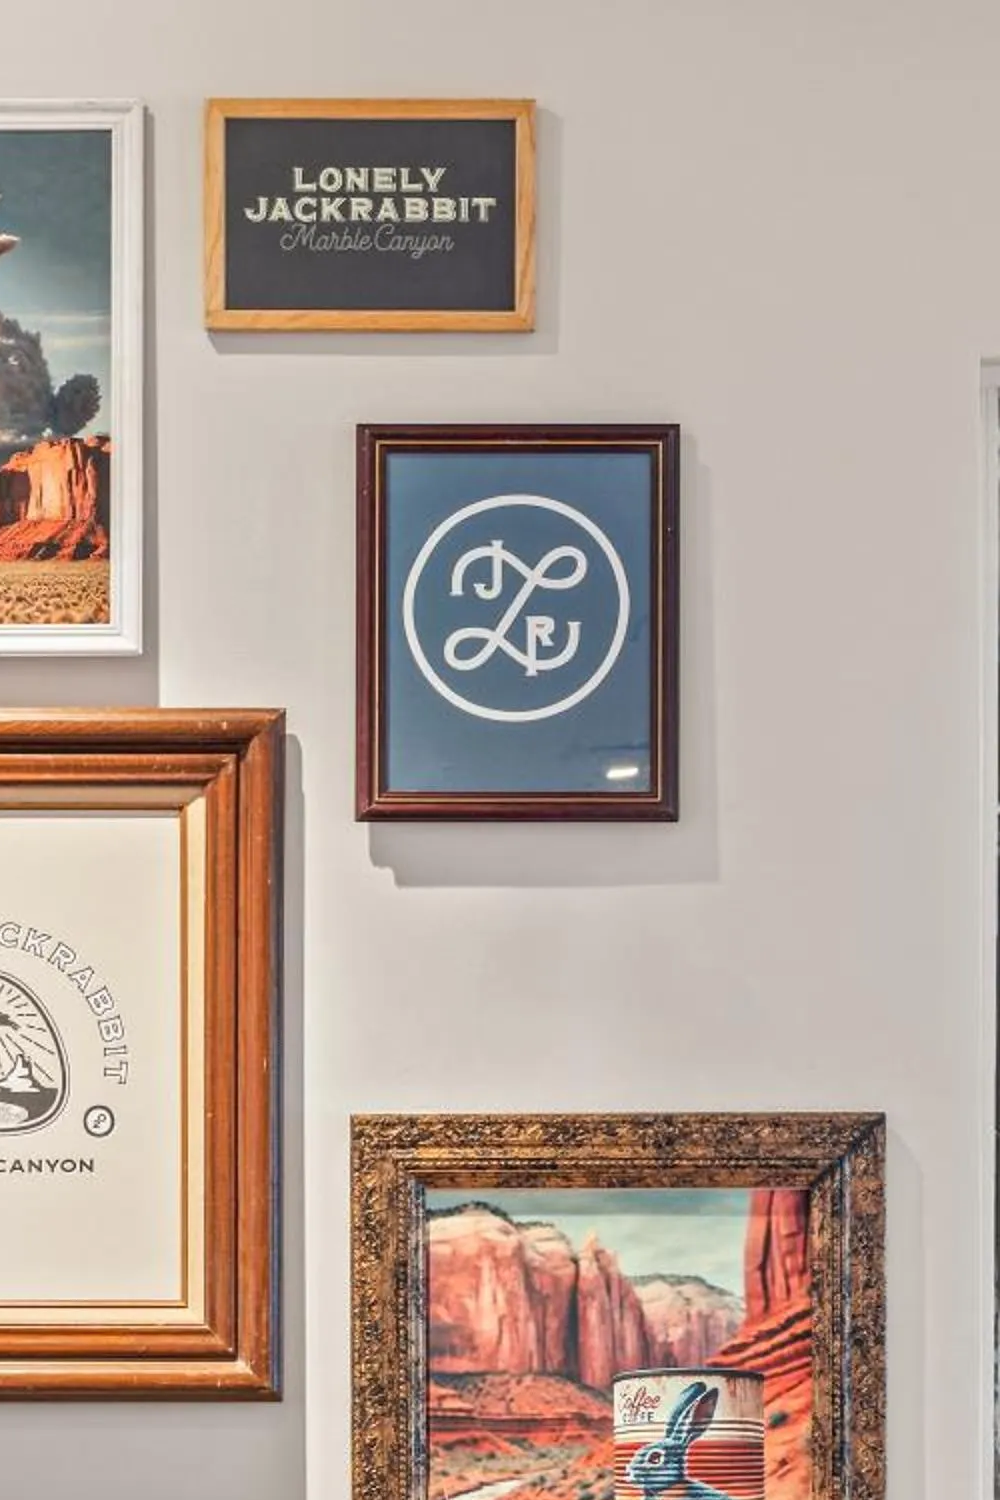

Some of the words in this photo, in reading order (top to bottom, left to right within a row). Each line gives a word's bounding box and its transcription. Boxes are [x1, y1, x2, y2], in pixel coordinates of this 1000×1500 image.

[293, 167, 447, 193] LONELY
[244, 197, 497, 223] JACKRABBIT
[279, 223, 373, 250] Marble
[374, 223, 455, 259] Canyon
